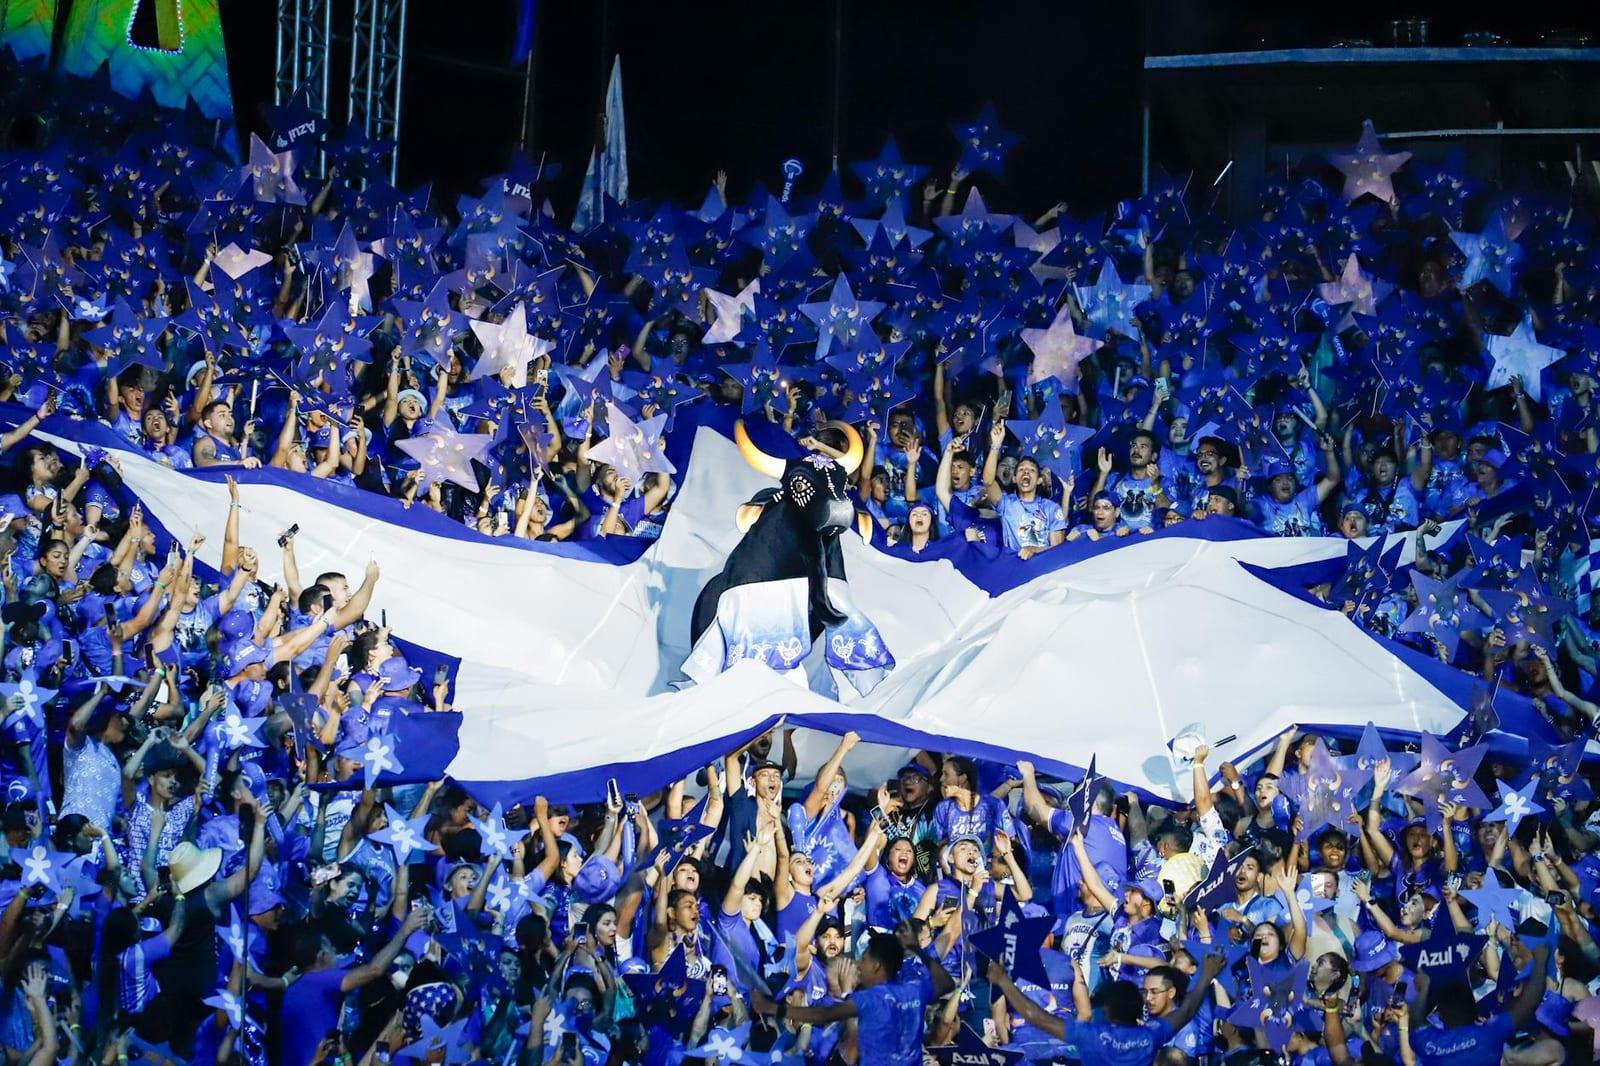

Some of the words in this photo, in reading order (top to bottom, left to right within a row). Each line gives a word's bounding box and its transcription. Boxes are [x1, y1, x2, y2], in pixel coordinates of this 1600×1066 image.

[288, 119, 316, 143] Azul
[511, 183, 531, 200] zul
[1195, 871, 1224, 903] Azul
[1417, 945, 1453, 968] Azul
[951, 1052, 990, 1066] Azul
